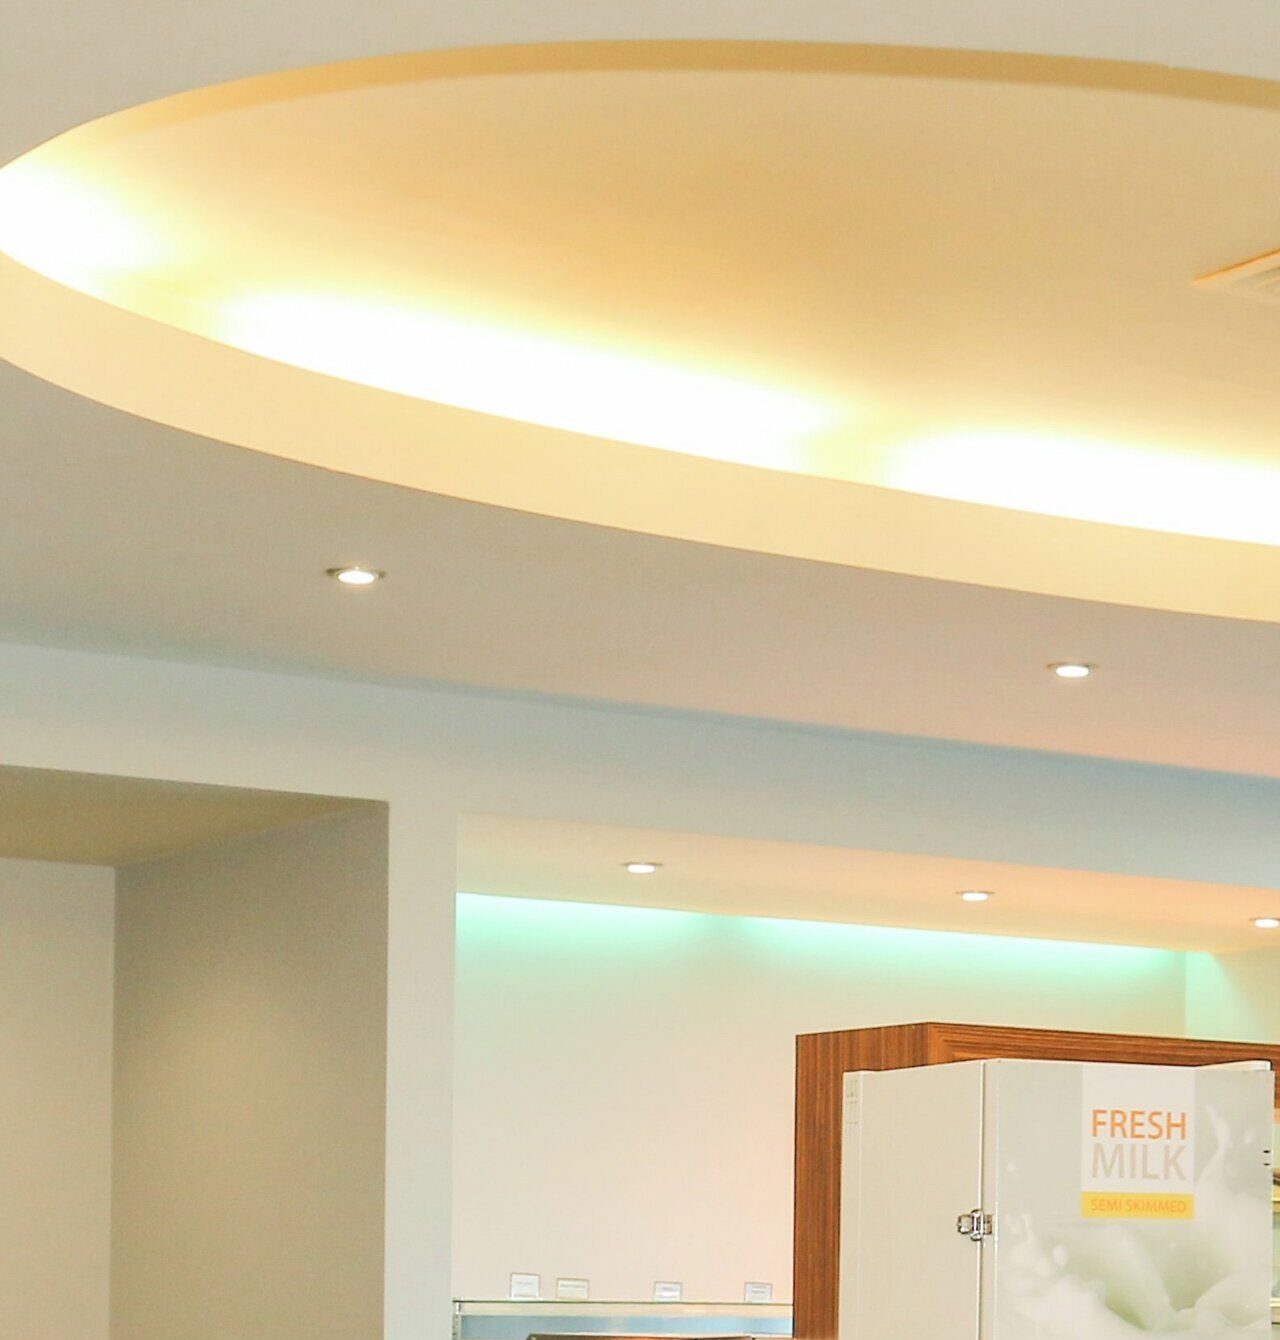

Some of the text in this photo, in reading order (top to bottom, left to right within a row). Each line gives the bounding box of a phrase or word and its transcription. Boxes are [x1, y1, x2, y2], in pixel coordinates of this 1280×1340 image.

[1091, 1109, 1187, 1140] FRESH
[1091, 1142, 1187, 1181] MILK
[1091, 1199, 1186, 1213] SEMI SKIMMED
